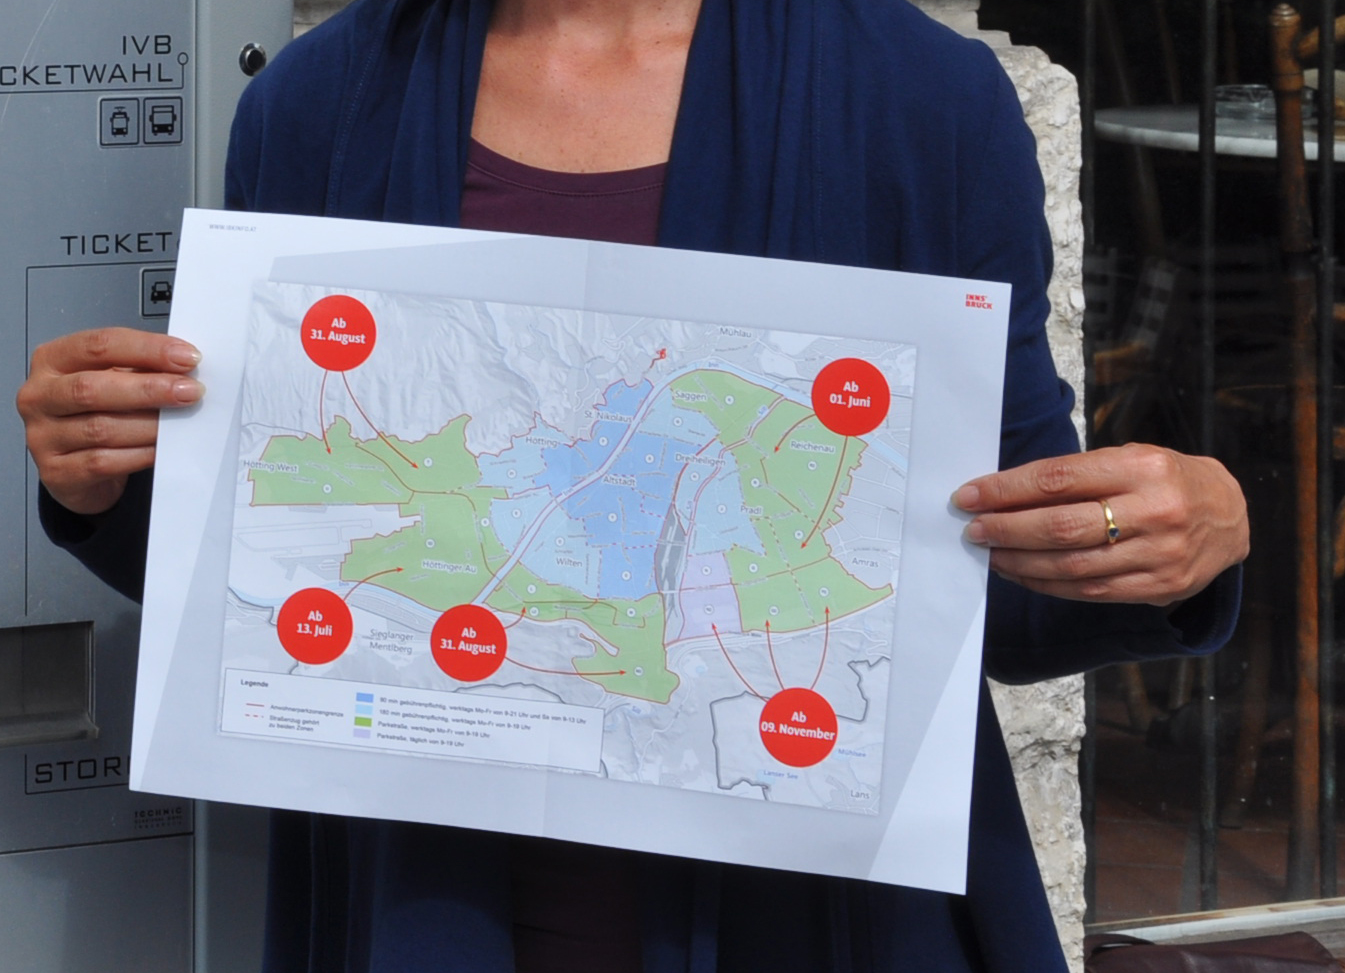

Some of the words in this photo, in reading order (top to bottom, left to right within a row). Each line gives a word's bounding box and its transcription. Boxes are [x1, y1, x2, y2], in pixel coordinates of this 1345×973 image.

[122, 34, 172, 55] IVB
[60, 232, 173, 255] TICKET
[965, 301, 993, 309] BRUCK
[331, 317, 346, 329] Ab
[310, 329, 326, 341] 31.
[328, 330, 366, 346] August
[719, 327, 752, 338] Mühlau
[843, 382, 859, 393] Ab
[675, 390, 707, 402] Saggen
[829, 394, 846, 405] 01.
[848, 395, 871, 409] Juni
[597, 412, 632, 422] Nikolaus
[791, 441, 835, 453] Reichenau
[675, 453, 726, 466] Dreiheiligen
[277, 463, 298, 472] West
[603, 476, 636, 486] Altstadt
[741, 505, 762, 515] Pradl
[422, 560, 462, 573] Höttinger
[465, 564, 477, 573] Au
[556, 557, 582, 567] Wilten
[852, 557, 879, 568] Amras
[308, 611, 323, 622] Ab
[297, 623, 311, 634] 13.
[313, 623, 333, 637] Juli
[461, 627, 477, 638] Ab
[370, 628, 413, 644] Sieglanger
[440, 639, 456, 651] 31.
[458, 640, 496, 655] August
[240, 679, 269, 688] Legende
[791, 711, 807, 722] Ab
[761, 722, 777, 733] 09.
[779, 723, 835, 740] November
[35, 757, 130, 784] STOR
[850, 789, 870, 799] Lans
